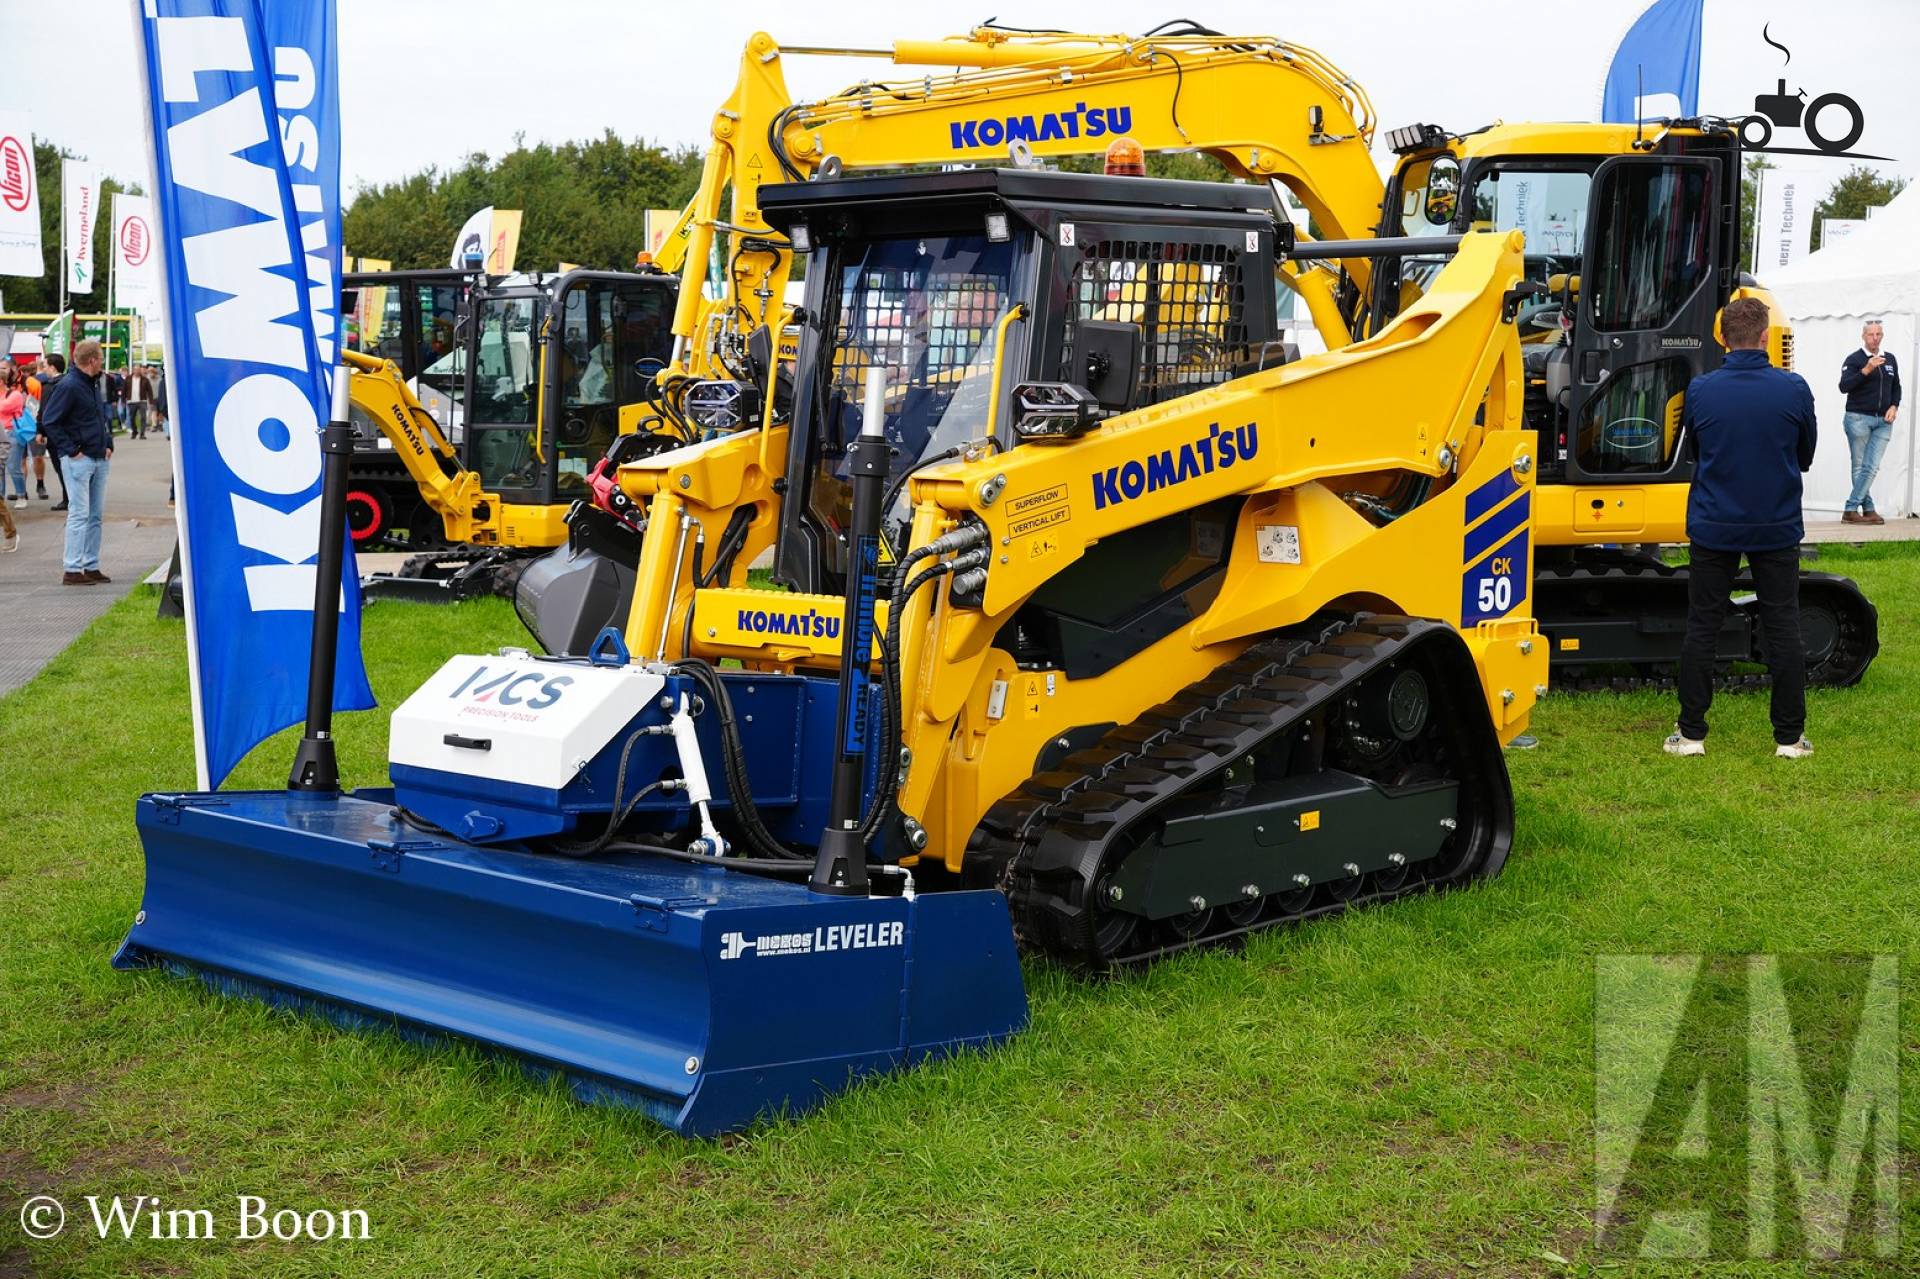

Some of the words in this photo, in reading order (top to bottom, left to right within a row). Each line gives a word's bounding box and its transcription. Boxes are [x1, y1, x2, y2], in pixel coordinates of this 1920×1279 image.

[950, 102, 1132, 149] KOMATSU
[0, 146, 24, 200] Vicon
[1515, 181, 1528, 227] Techniek
[1781, 184, 1795, 234] Techniek
[77, 186, 90, 260] Kverneland
[124, 222, 143, 259] Vicon
[1661, 337, 1700, 348] KOMATSU
[392, 403, 425, 455] KOMATSU
[1092, 422, 1258, 510] KOMATSU
[1015, 490, 1058, 510] SUPERFLOW
[1013, 516, 1050, 533] VERTICAL
[1050, 510, 1065, 521] LIFT
[1492, 558, 1511, 575] CK
[1478, 577, 1511, 612] 50
[738, 608, 840, 638] KOMATSU
[463, 705, 509, 720] PRECISION
[854, 684, 869, 744] READY
[815, 921, 904, 952] LEVELER
